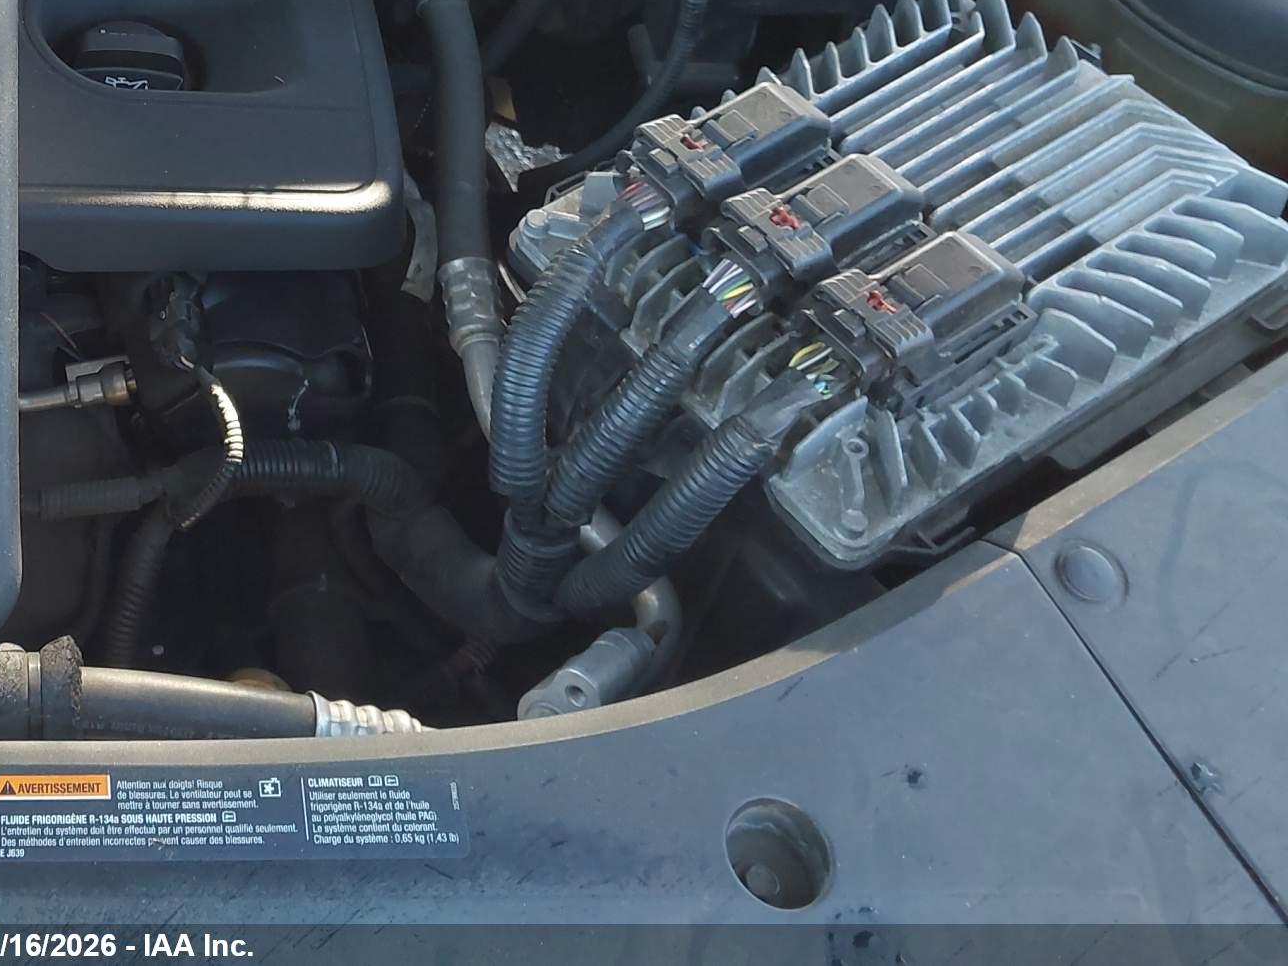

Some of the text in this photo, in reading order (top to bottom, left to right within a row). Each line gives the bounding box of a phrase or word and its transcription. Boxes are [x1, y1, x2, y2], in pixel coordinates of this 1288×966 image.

[18, 783, 101, 794] AVERTISSEMENT
[116, 780, 150, 790] Attention
[153, 781, 167, 789] aux
[197, 780, 223, 790] Risque
[308, 778, 363, 788] CLIMATISEUR
[117, 791, 127, 800] de
[170, 790, 180, 799] Le
[182, 790, 222, 798] ventilateur
[224, 789, 241, 800] peut
[242, 790, 252, 798] se
[310, 790, 410, 801] Utiliser seulement le fluide
[118, 801, 143, 810] mettre
[152, 801, 180, 809] tourner
[202, 800, 259, 809] avertissement.
[354, 802, 383, 811] R-134a
[385, 802, 392, 810] et
[394, 801, 404, 810] de
[1, 813, 216, 825] FLUIDE FRIGORIGÈNE R-134a SOUS HAUTE PRESSION
[312, 814, 322, 822] au
[396, 812, 417, 822] (huile
[1, 826, 42, 836] L'entretien
[44, 826, 54, 836] du
[56, 826, 88, 836] système
[90, 826, 105, 835] doit
[107, 824, 122, 834] être
[158, 826, 170, 836] par
[173, 826, 182, 834] un
[185, 824, 222, 836] personnel
[255, 822, 298, 833] seulement.
[312, 824, 323, 834] Le
[324, 824, 357, 834] système
[358, 823, 390, 832] contient
[392, 823, 402, 832] du
[2, 837, 16, 847] Des
[18, 836, 57, 846] méthodes
[58, 836, 100, 846] d'entretien
[102, 836, 146, 846] incorrectes
[148, 836, 179, 847] pvent
[181, 837, 207, 845] causer
[210, 836, 224, 845] des
[314, 834, 342, 846] Charge
[344, 834, 354, 844] du
[356, 834, 389, 845] système
[414, 834, 425, 845] kg
[449, 833, 460, 844] lb)
[6, 848, 25, 858] J639
